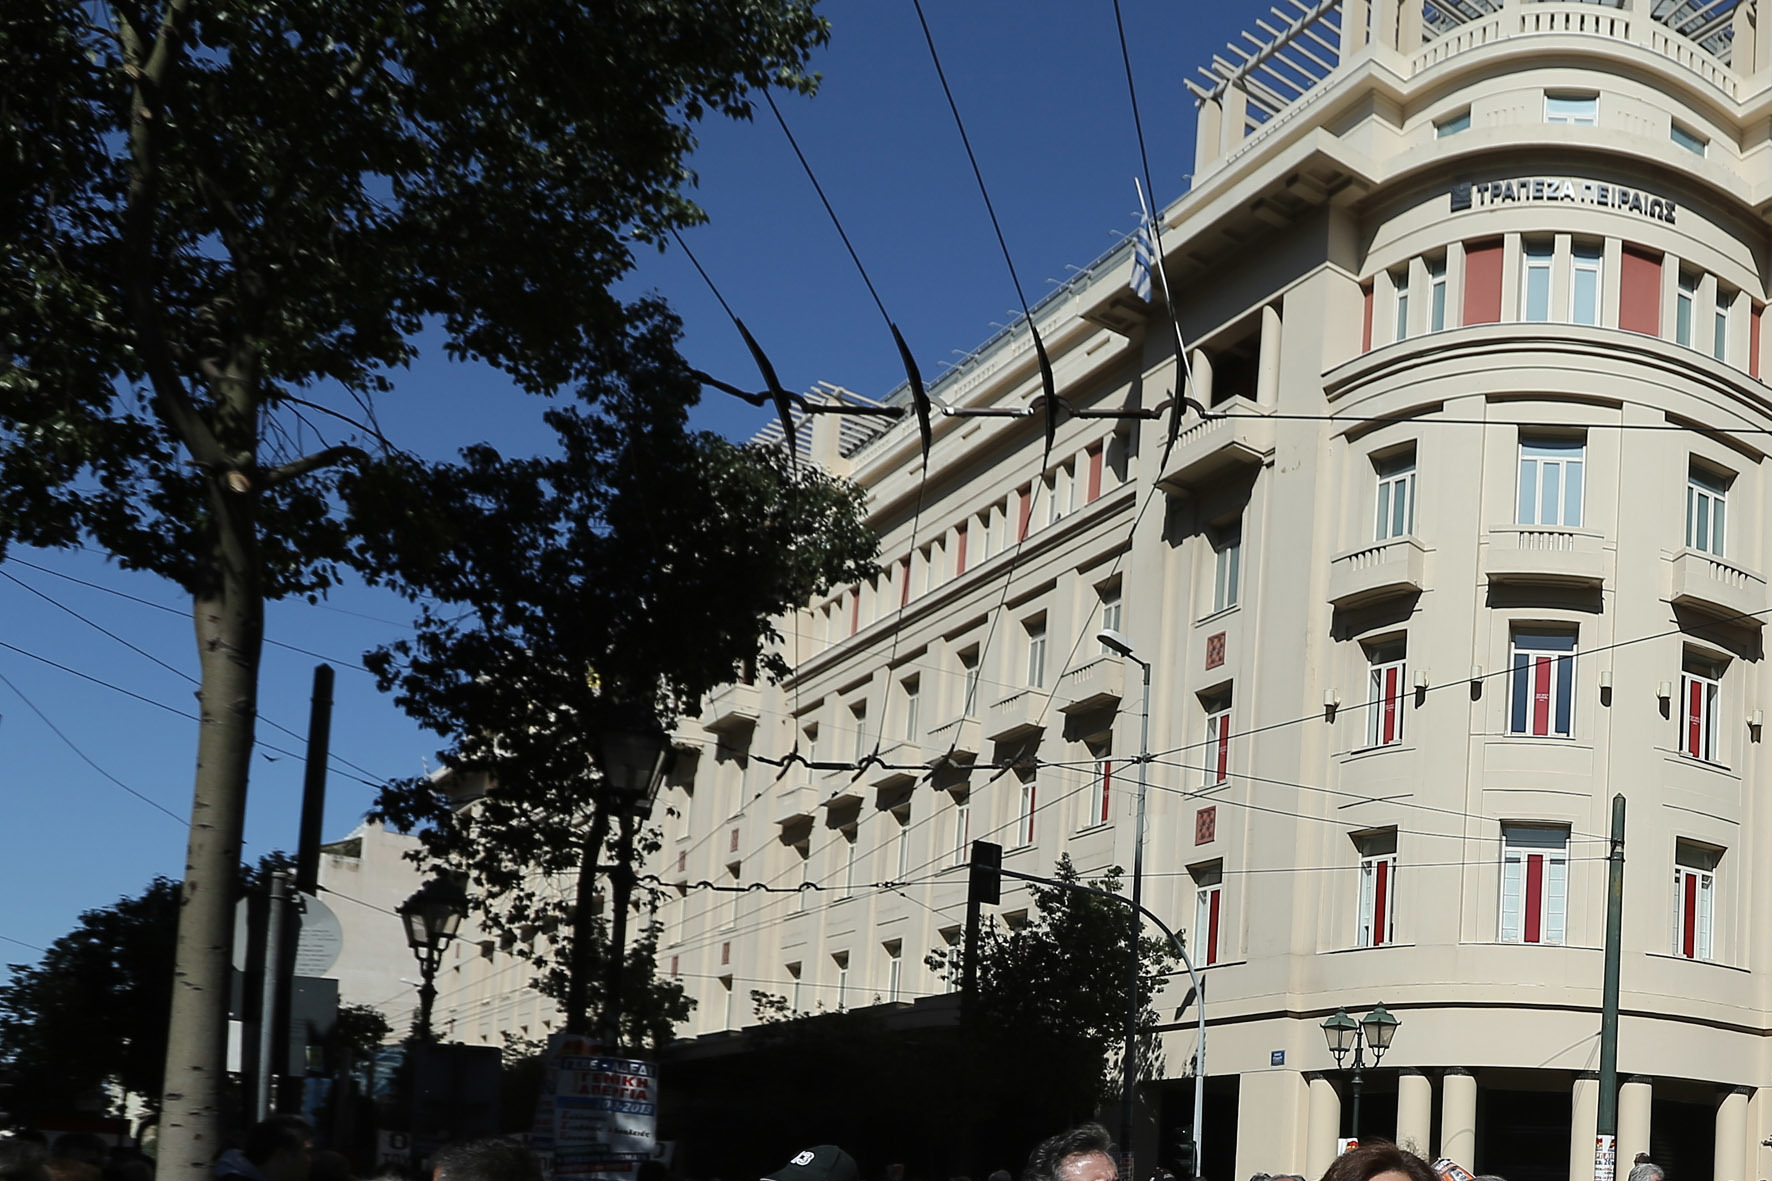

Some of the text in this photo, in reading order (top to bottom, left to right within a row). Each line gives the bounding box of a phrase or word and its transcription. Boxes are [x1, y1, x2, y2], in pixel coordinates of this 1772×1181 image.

[1476, 178, 1677, 225] ΤΡΑΠΕΖΑ ΠΕΙΡΑΙΩΣ
[582, 1072, 649, 1088] ΓΕΝΙΚΗ
